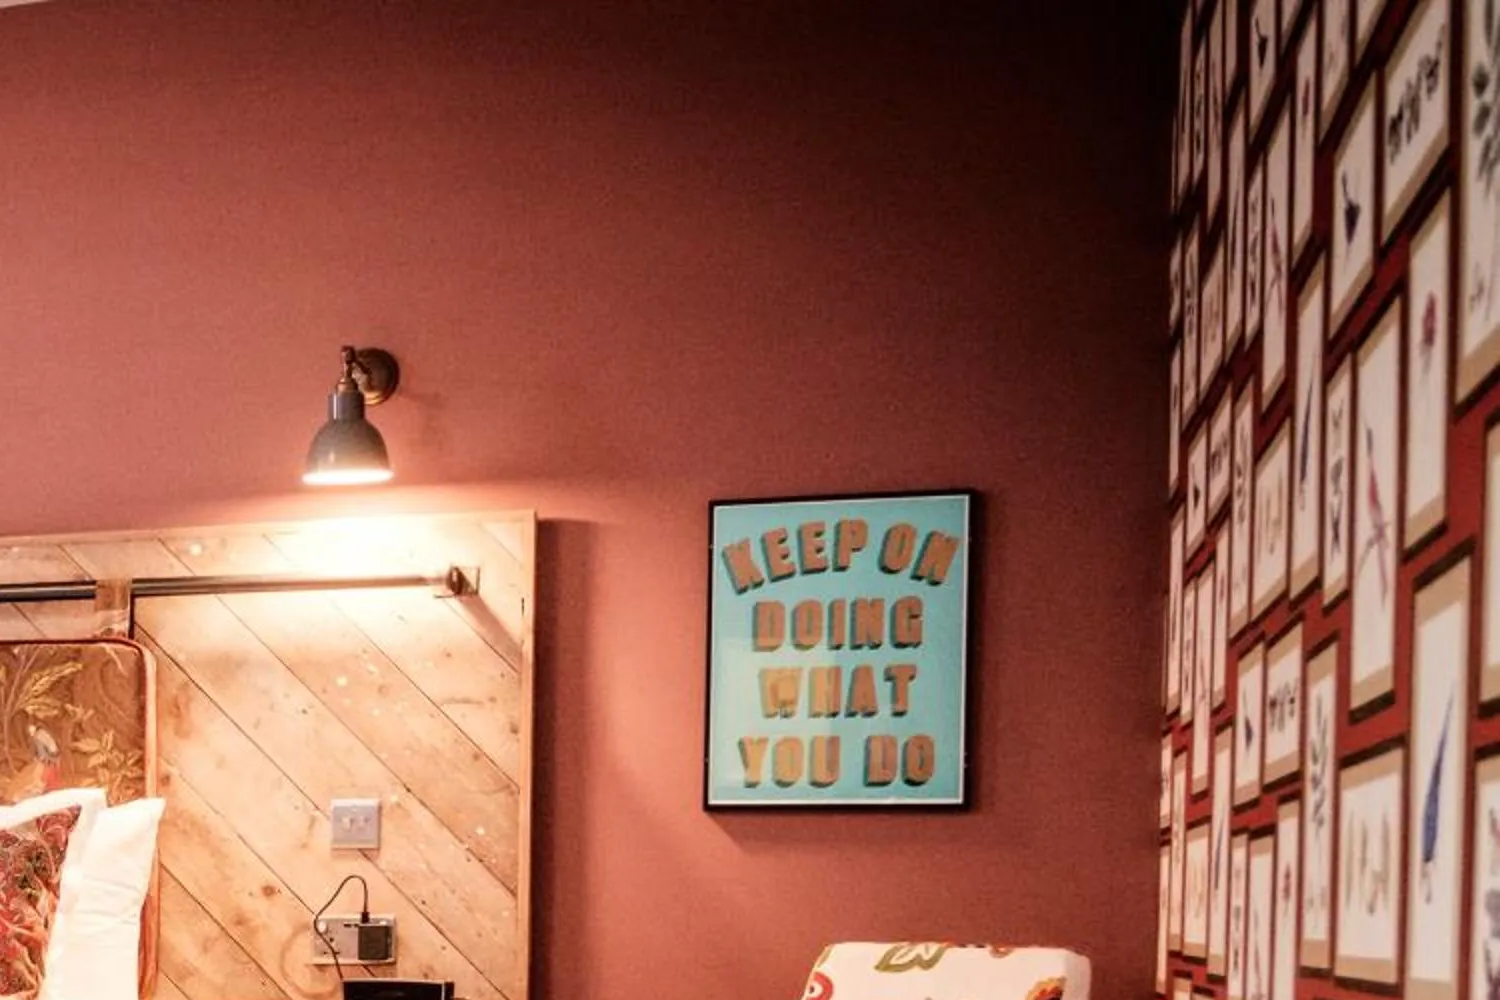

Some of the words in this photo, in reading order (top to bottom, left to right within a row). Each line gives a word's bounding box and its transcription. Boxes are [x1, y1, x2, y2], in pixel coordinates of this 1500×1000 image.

[722, 519, 868, 594] KEEP
[879, 522, 961, 585] ON
[752, 596, 924, 651] DOING
[758, 664, 918, 719] WHAT
[738, 735, 841, 788] YOU
[864, 734, 935, 787] DO
